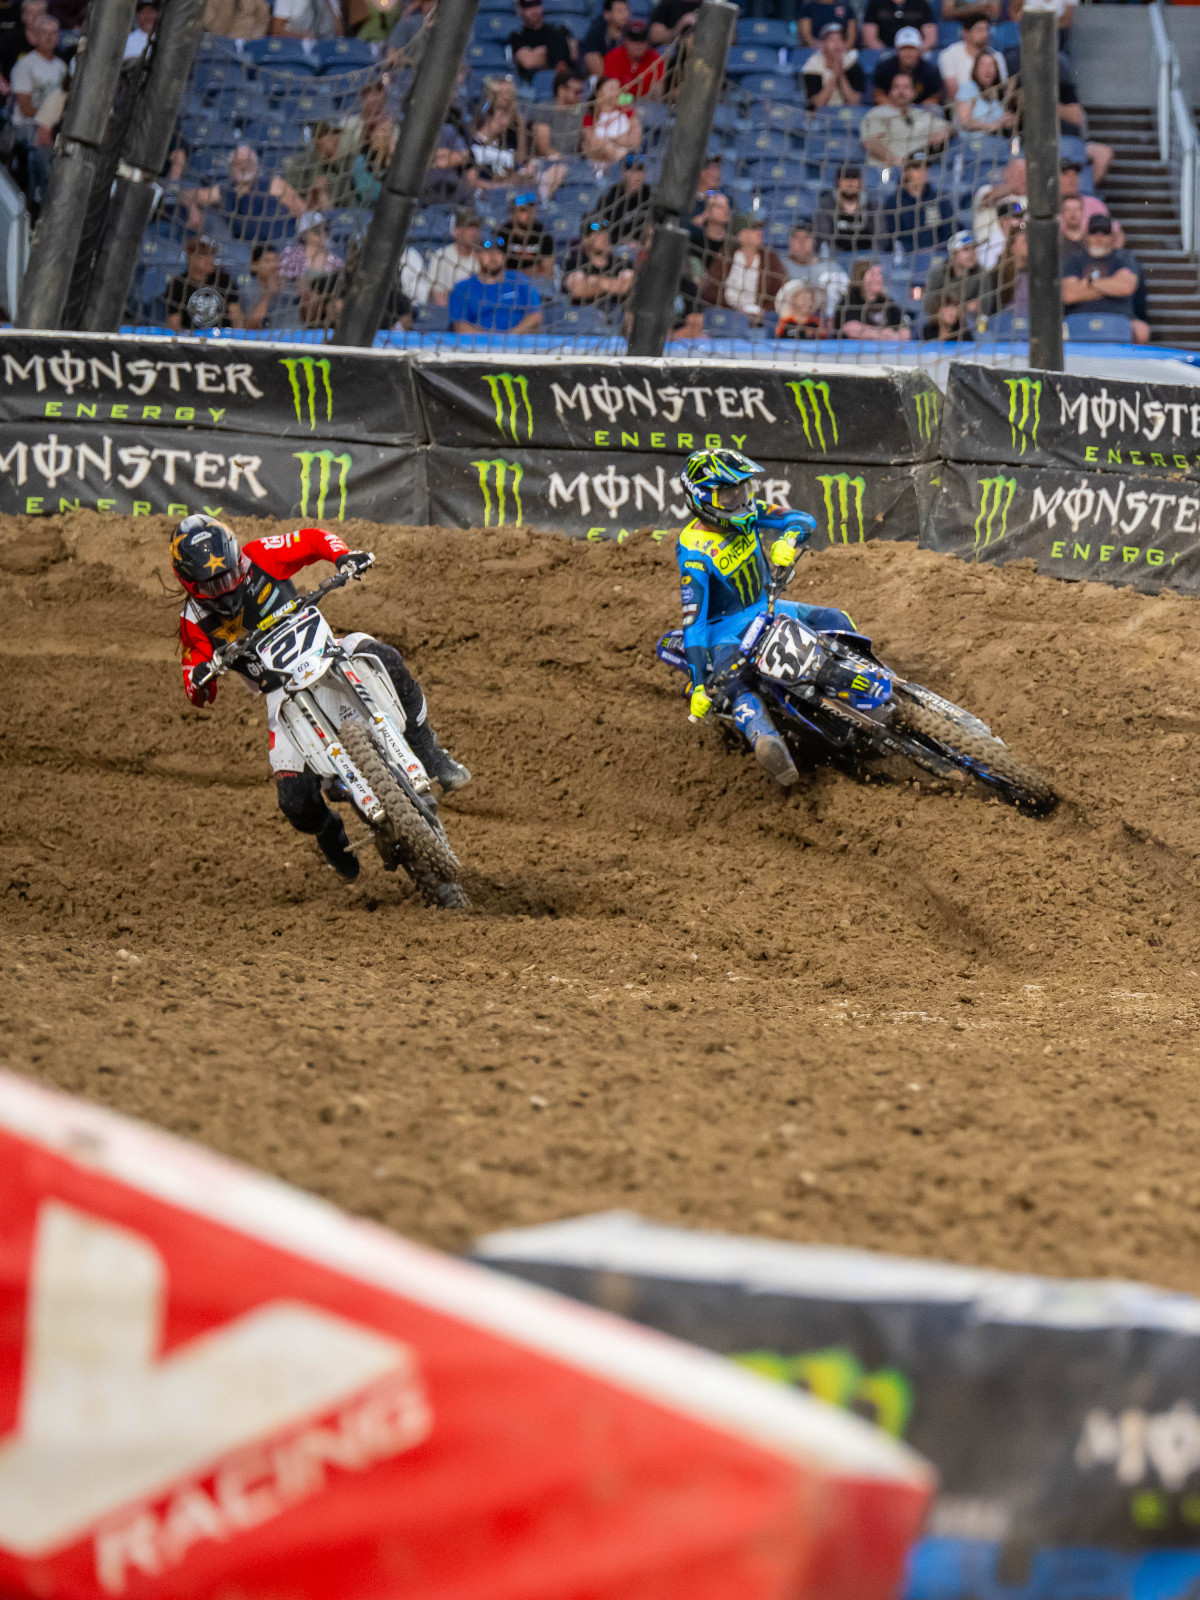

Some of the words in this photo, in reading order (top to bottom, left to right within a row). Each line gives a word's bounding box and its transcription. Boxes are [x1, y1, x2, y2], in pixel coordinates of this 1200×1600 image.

[2, 349, 264, 399] MONSTER
[44, 401, 226, 422] ENERGY
[550, 377, 777, 424] MONSTER
[594, 430, 748, 449] ENERGY
[270, 612, 320, 669] 27
[765, 618, 817, 681] 32
[95, 1375, 437, 1595] RACING
